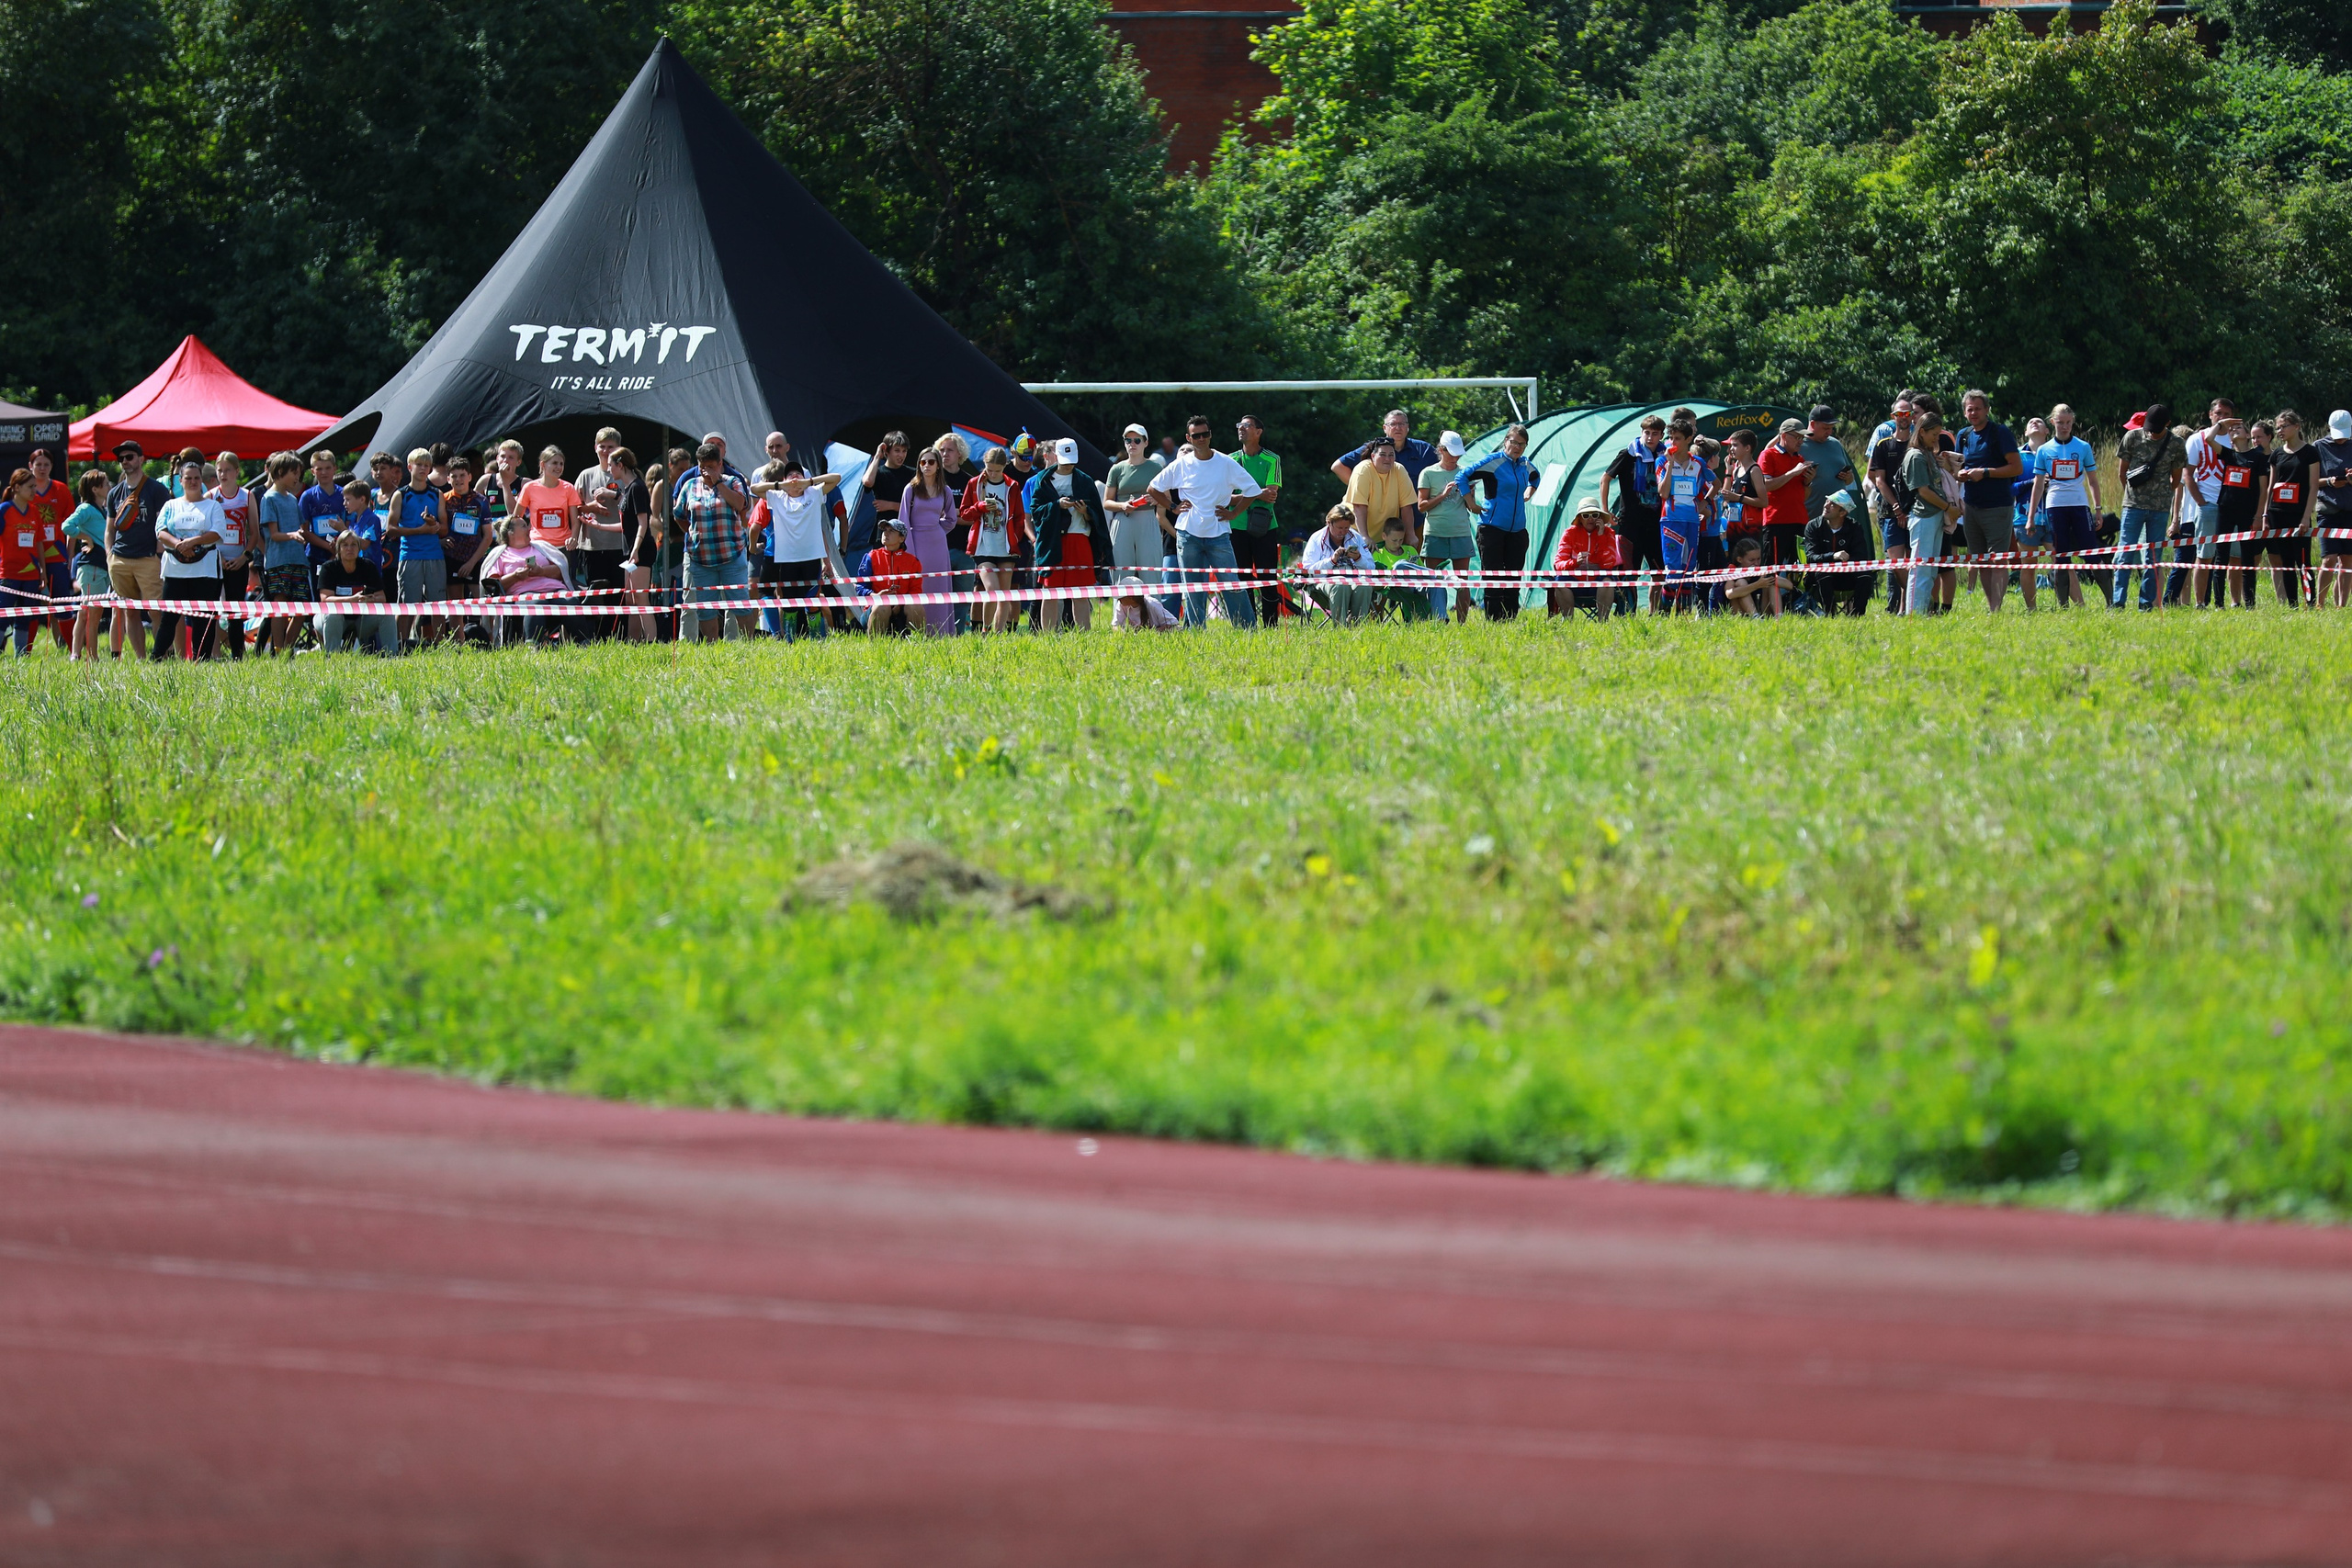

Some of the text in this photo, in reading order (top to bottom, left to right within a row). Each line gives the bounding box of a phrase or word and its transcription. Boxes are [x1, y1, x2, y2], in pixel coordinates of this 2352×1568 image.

[509, 321, 717, 366] TERMIT
[550, 376, 655, 390] IT'S ALL RIDE
[34, 433, 61, 441] BAND
